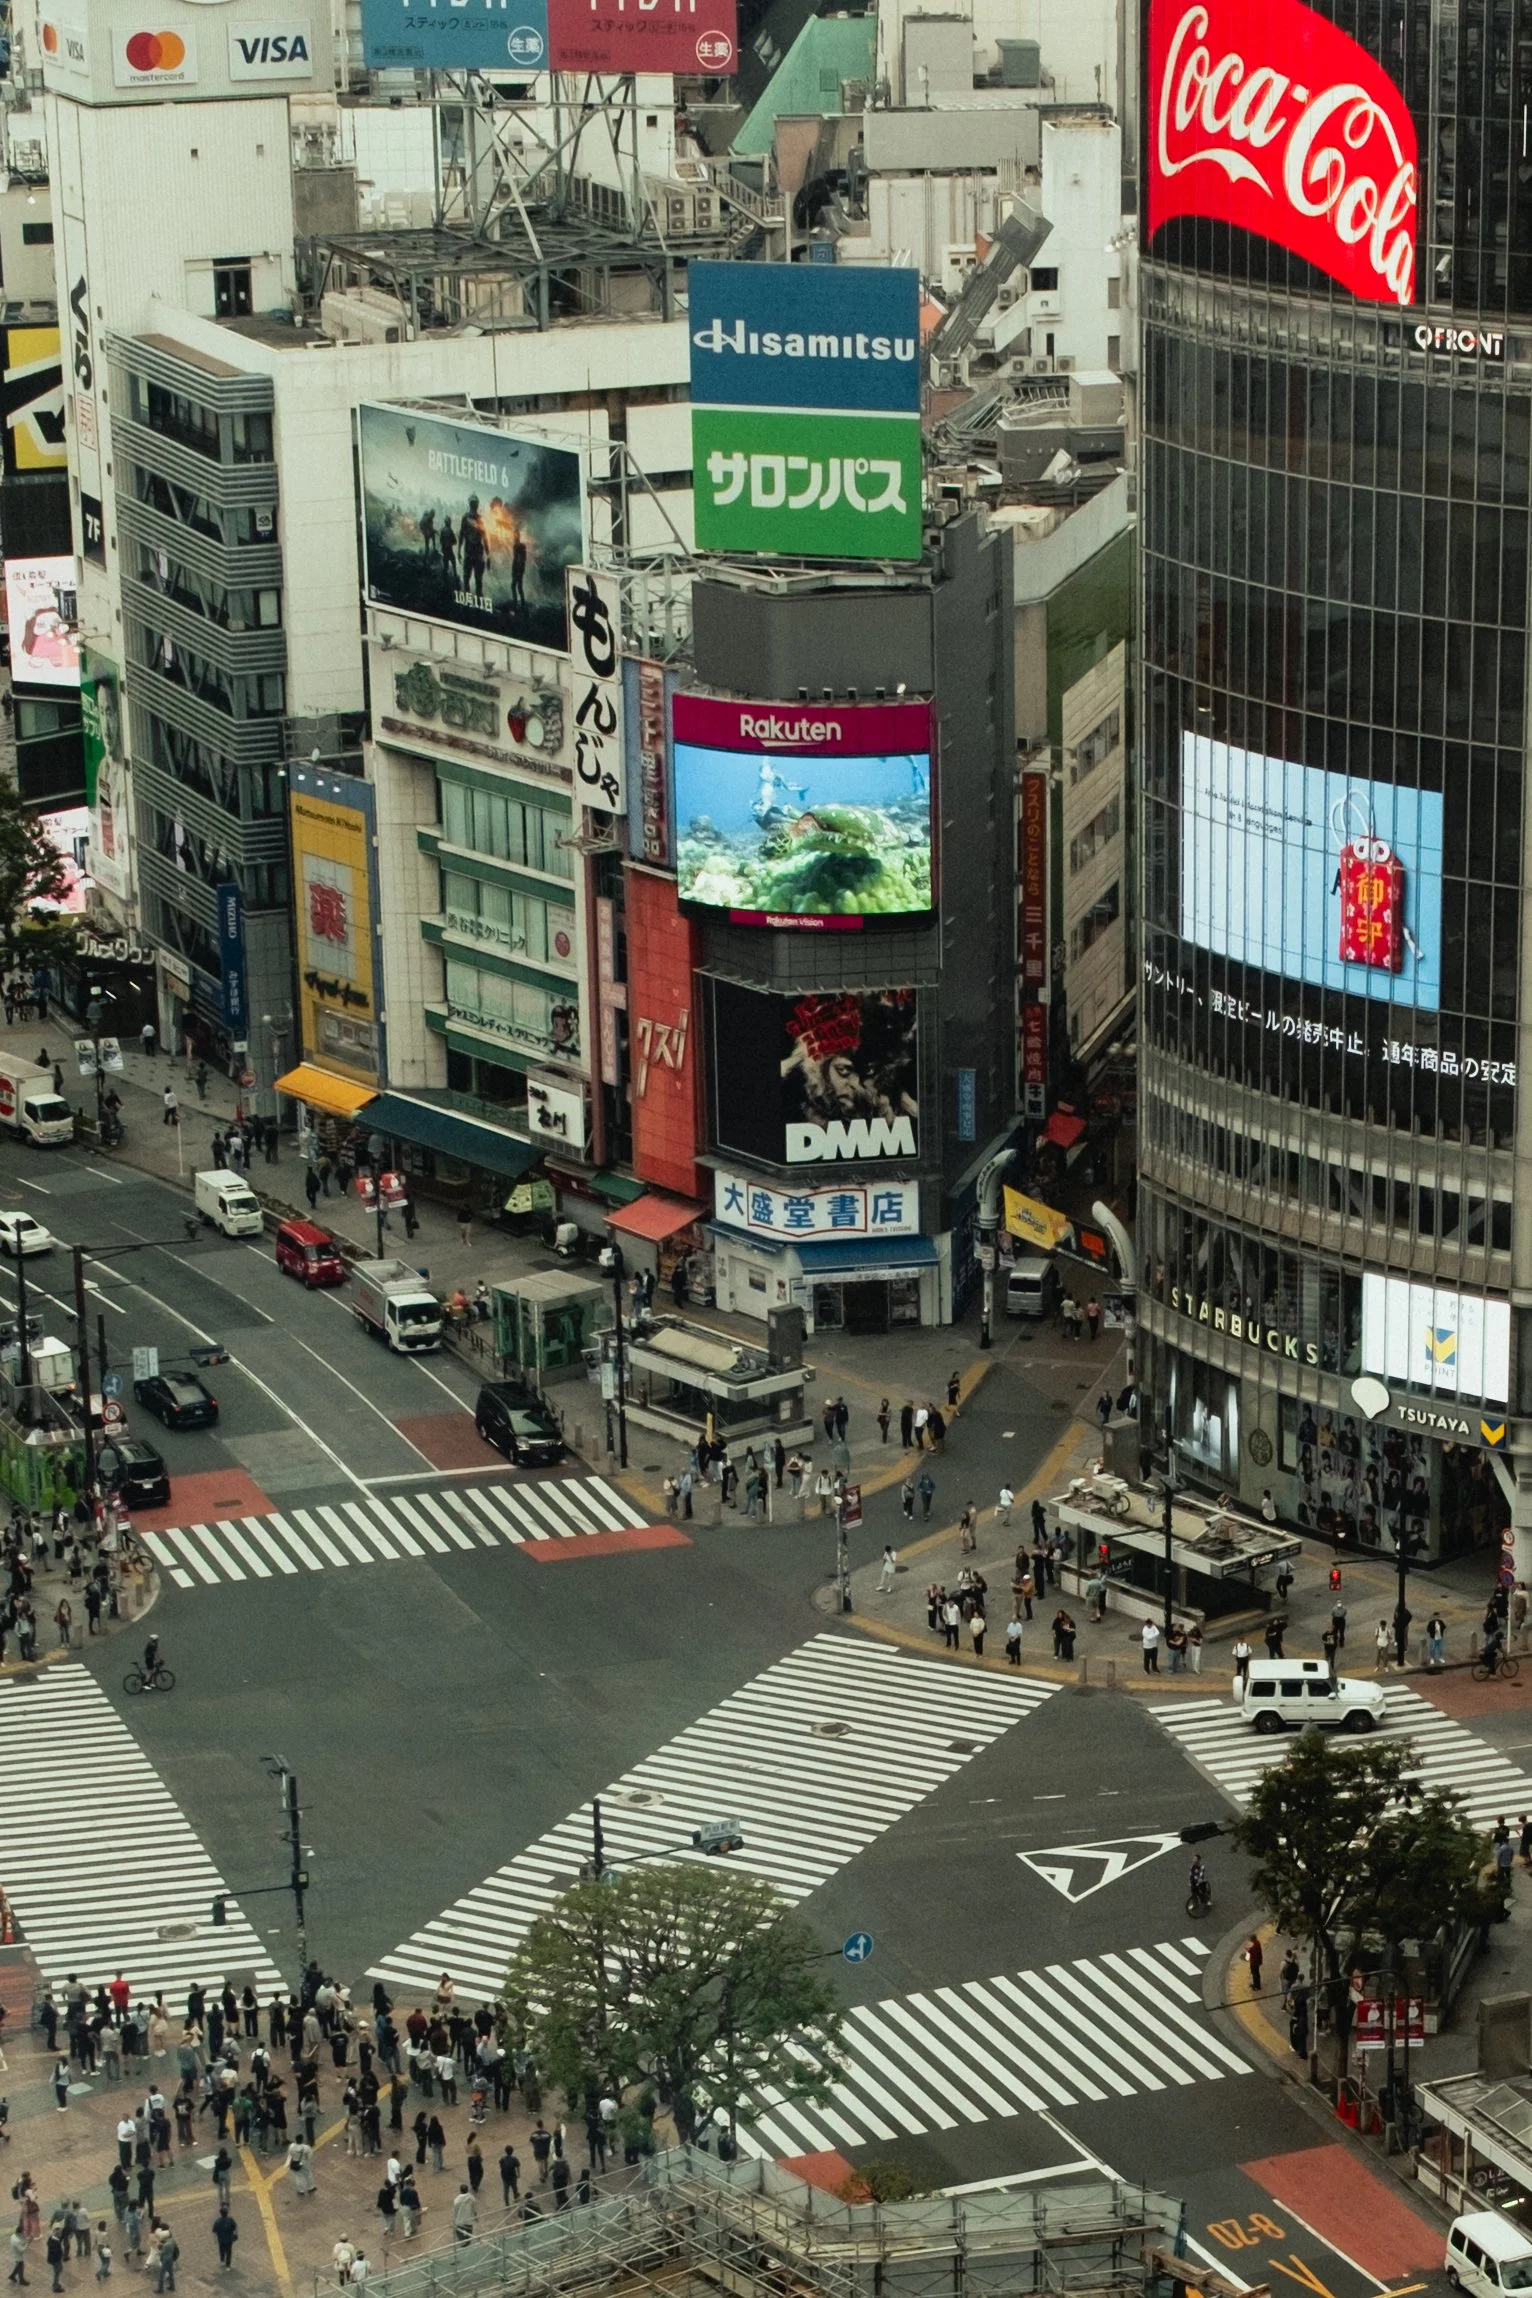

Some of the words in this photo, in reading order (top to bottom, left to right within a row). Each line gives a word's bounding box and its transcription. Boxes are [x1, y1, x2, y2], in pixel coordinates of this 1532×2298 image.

[405, 16, 459, 30] スティック
[592, 19, 648, 33] スティック
[66, 38, 85, 62] VISA
[234, 36, 309, 64] VISA
[511, 37, 540, 53] 生薬
[700, 42, 728, 57] 生薬
[129, 71, 185, 82] mastercard
[1159, 4, 1417, 305] Coca-Cola
[693, 319, 915, 362] Hisamitsu
[1414, 325, 1504, 356] QFRONT
[428, 449, 498, 485] BATTLEFIELD
[501, 466, 509, 488] 6
[707, 451, 907, 515] サロンパス
[84, 513, 101, 543] 7F
[572, 574, 620, 808] もんじゃ
[739, 714, 842, 742] Rakuten
[227, 896, 237, 940] MIZUHO
[766, 915, 798, 927] Rakuten
[799, 917, 824, 927] Vision
[1356, 874, 1384, 950] 御守
[637, 1008, 690, 1100] クスリ
[785, 1115, 917, 1163] DMM
[723, 1182, 904, 1230] 大盛堂書店
[1171, 1287, 1318, 1365] STARBUCKS
[1424, 1364, 1456, 1377] POINT
[1397, 1405, 1471, 1436] TSUTAYA
[1206, 2213, 1286, 2250] 8-20
